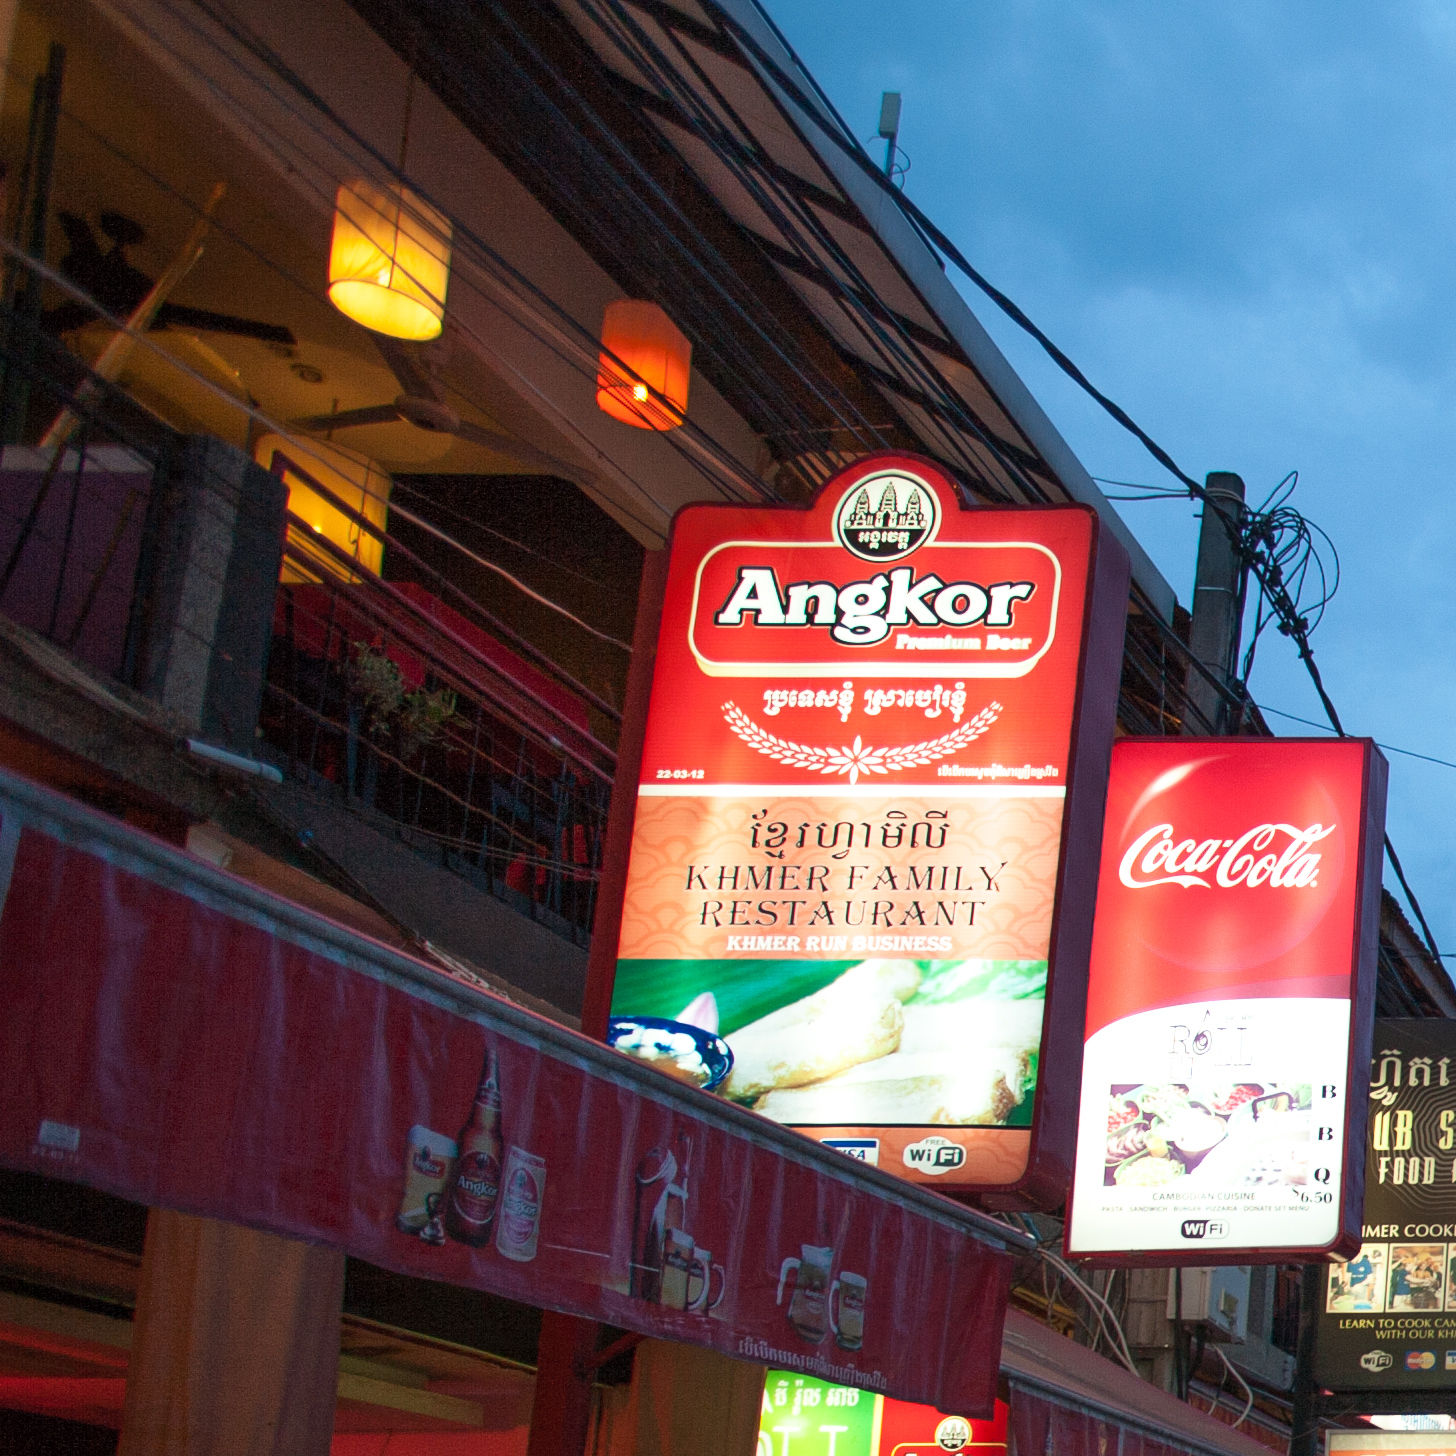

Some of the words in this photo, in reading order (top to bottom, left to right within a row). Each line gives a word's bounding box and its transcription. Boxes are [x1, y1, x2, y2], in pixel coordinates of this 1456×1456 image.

[715, 566, 1036, 646] Angkor
[895, 633, 981, 651] Premium
[985, 633, 1032, 651] Beer
[1118, 822, 1337, 889] Coca-Cola
[684, 863, 834, 894] KHMER
[847, 860, 1009, 893] FAMILY
[699, 899, 986, 928] RESTAURANT
[726, 935, 801, 952] KHMER
[806, 935, 848, 952] RUN
[852, 935, 952, 952] BUSINESS
[1373, 1109, 1413, 1151] UB
[1378, 1156, 1435, 1184] FOOD
[457, 1175, 498, 1197] Angkor
[1217, 1192, 1256, 1201] CUISINE
[1339, 1319, 1375, 1329] LEARN
[1378, 1319, 1394, 1329] TO
[1397, 1319, 1431, 1328] COOK
[1375, 1330, 1406, 1339] WITH
[1408, 1329, 1435, 1339] OUR
